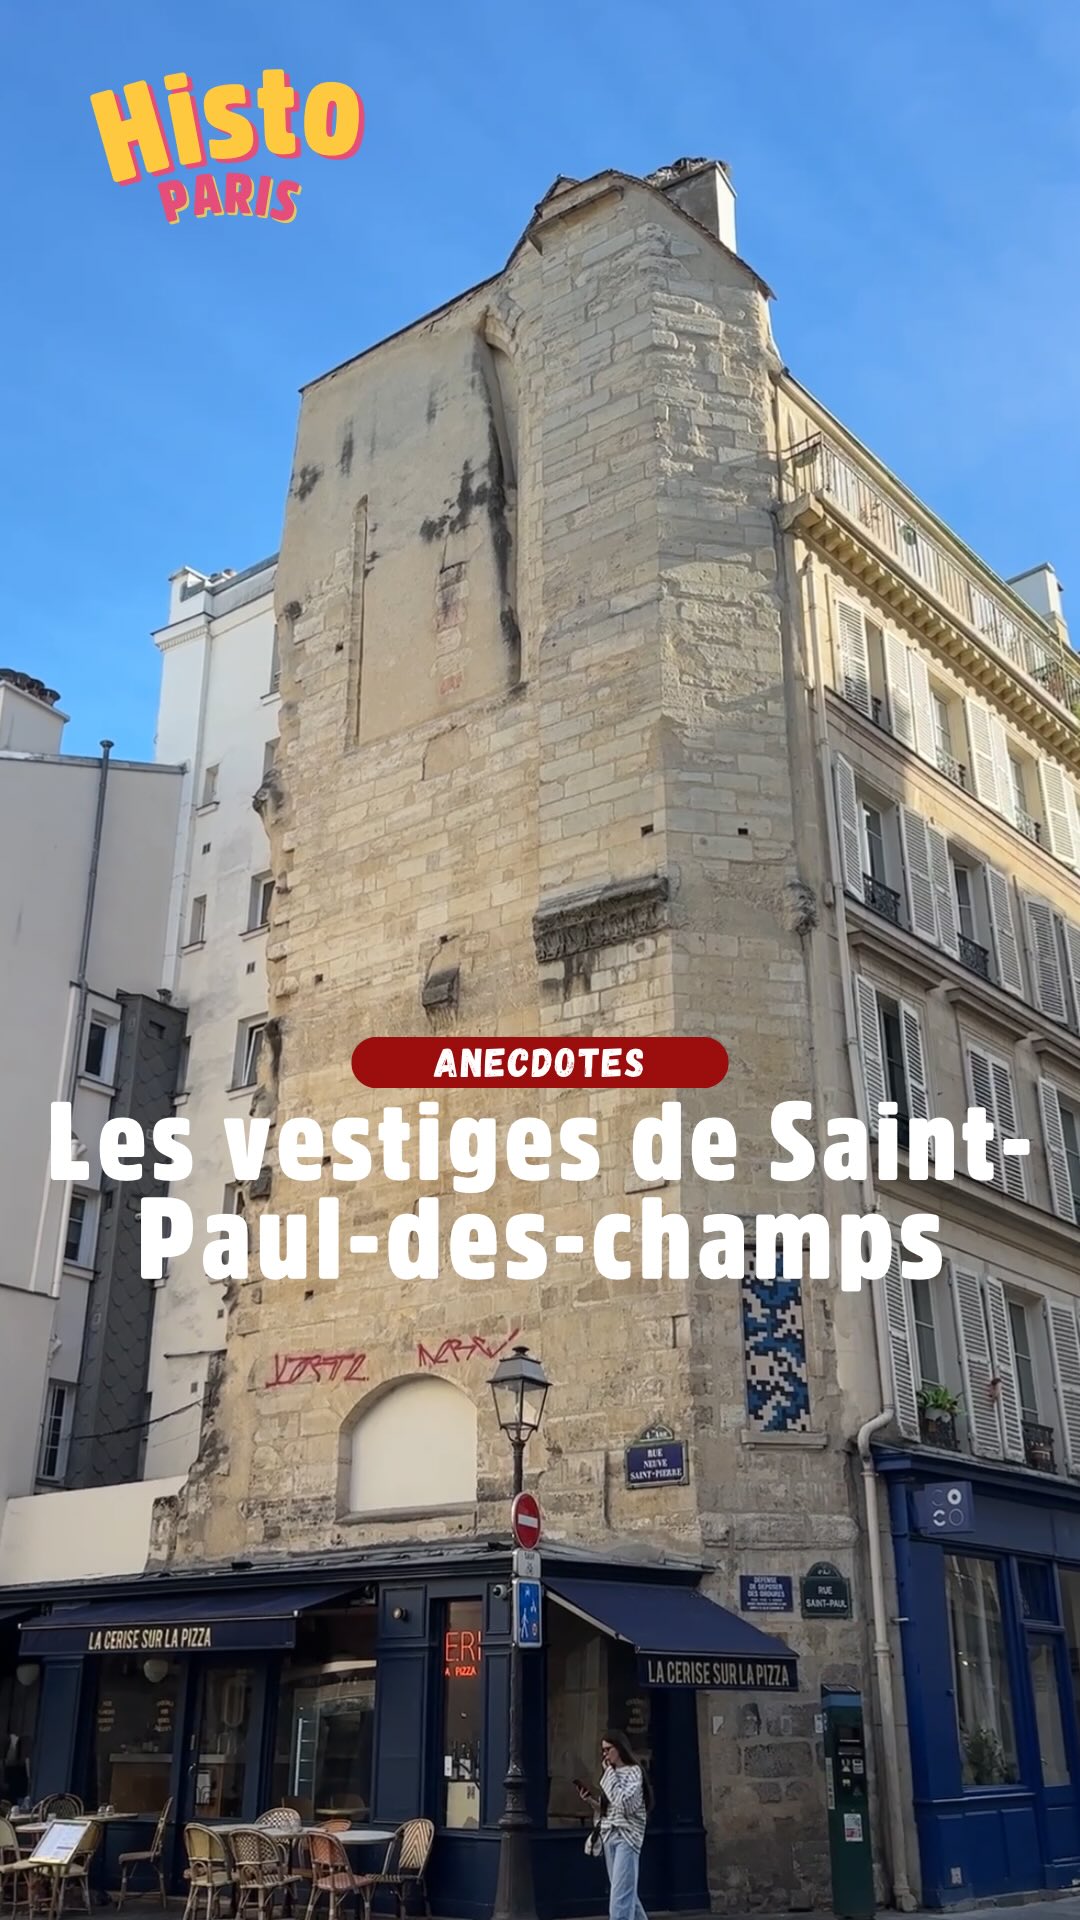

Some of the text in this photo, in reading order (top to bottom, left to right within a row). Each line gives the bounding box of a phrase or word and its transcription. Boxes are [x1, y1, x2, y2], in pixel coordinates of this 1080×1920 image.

[647, 1448, 663, 1458] RUE
[643, 1459, 668, 1469] NEUVE
[630, 1468, 682, 1480] SAINT-PIERRE
[818, 1585, 833, 1595] RUE
[806, 1598, 847, 1608] SAINT-PAUL
[88, 1627, 211, 1650] LA CERISE SUR LA PIZZA
[455, 1666, 477, 1676] PIZZA
[647, 1660, 790, 1686] LA CERISE SUR LA PIZZA
